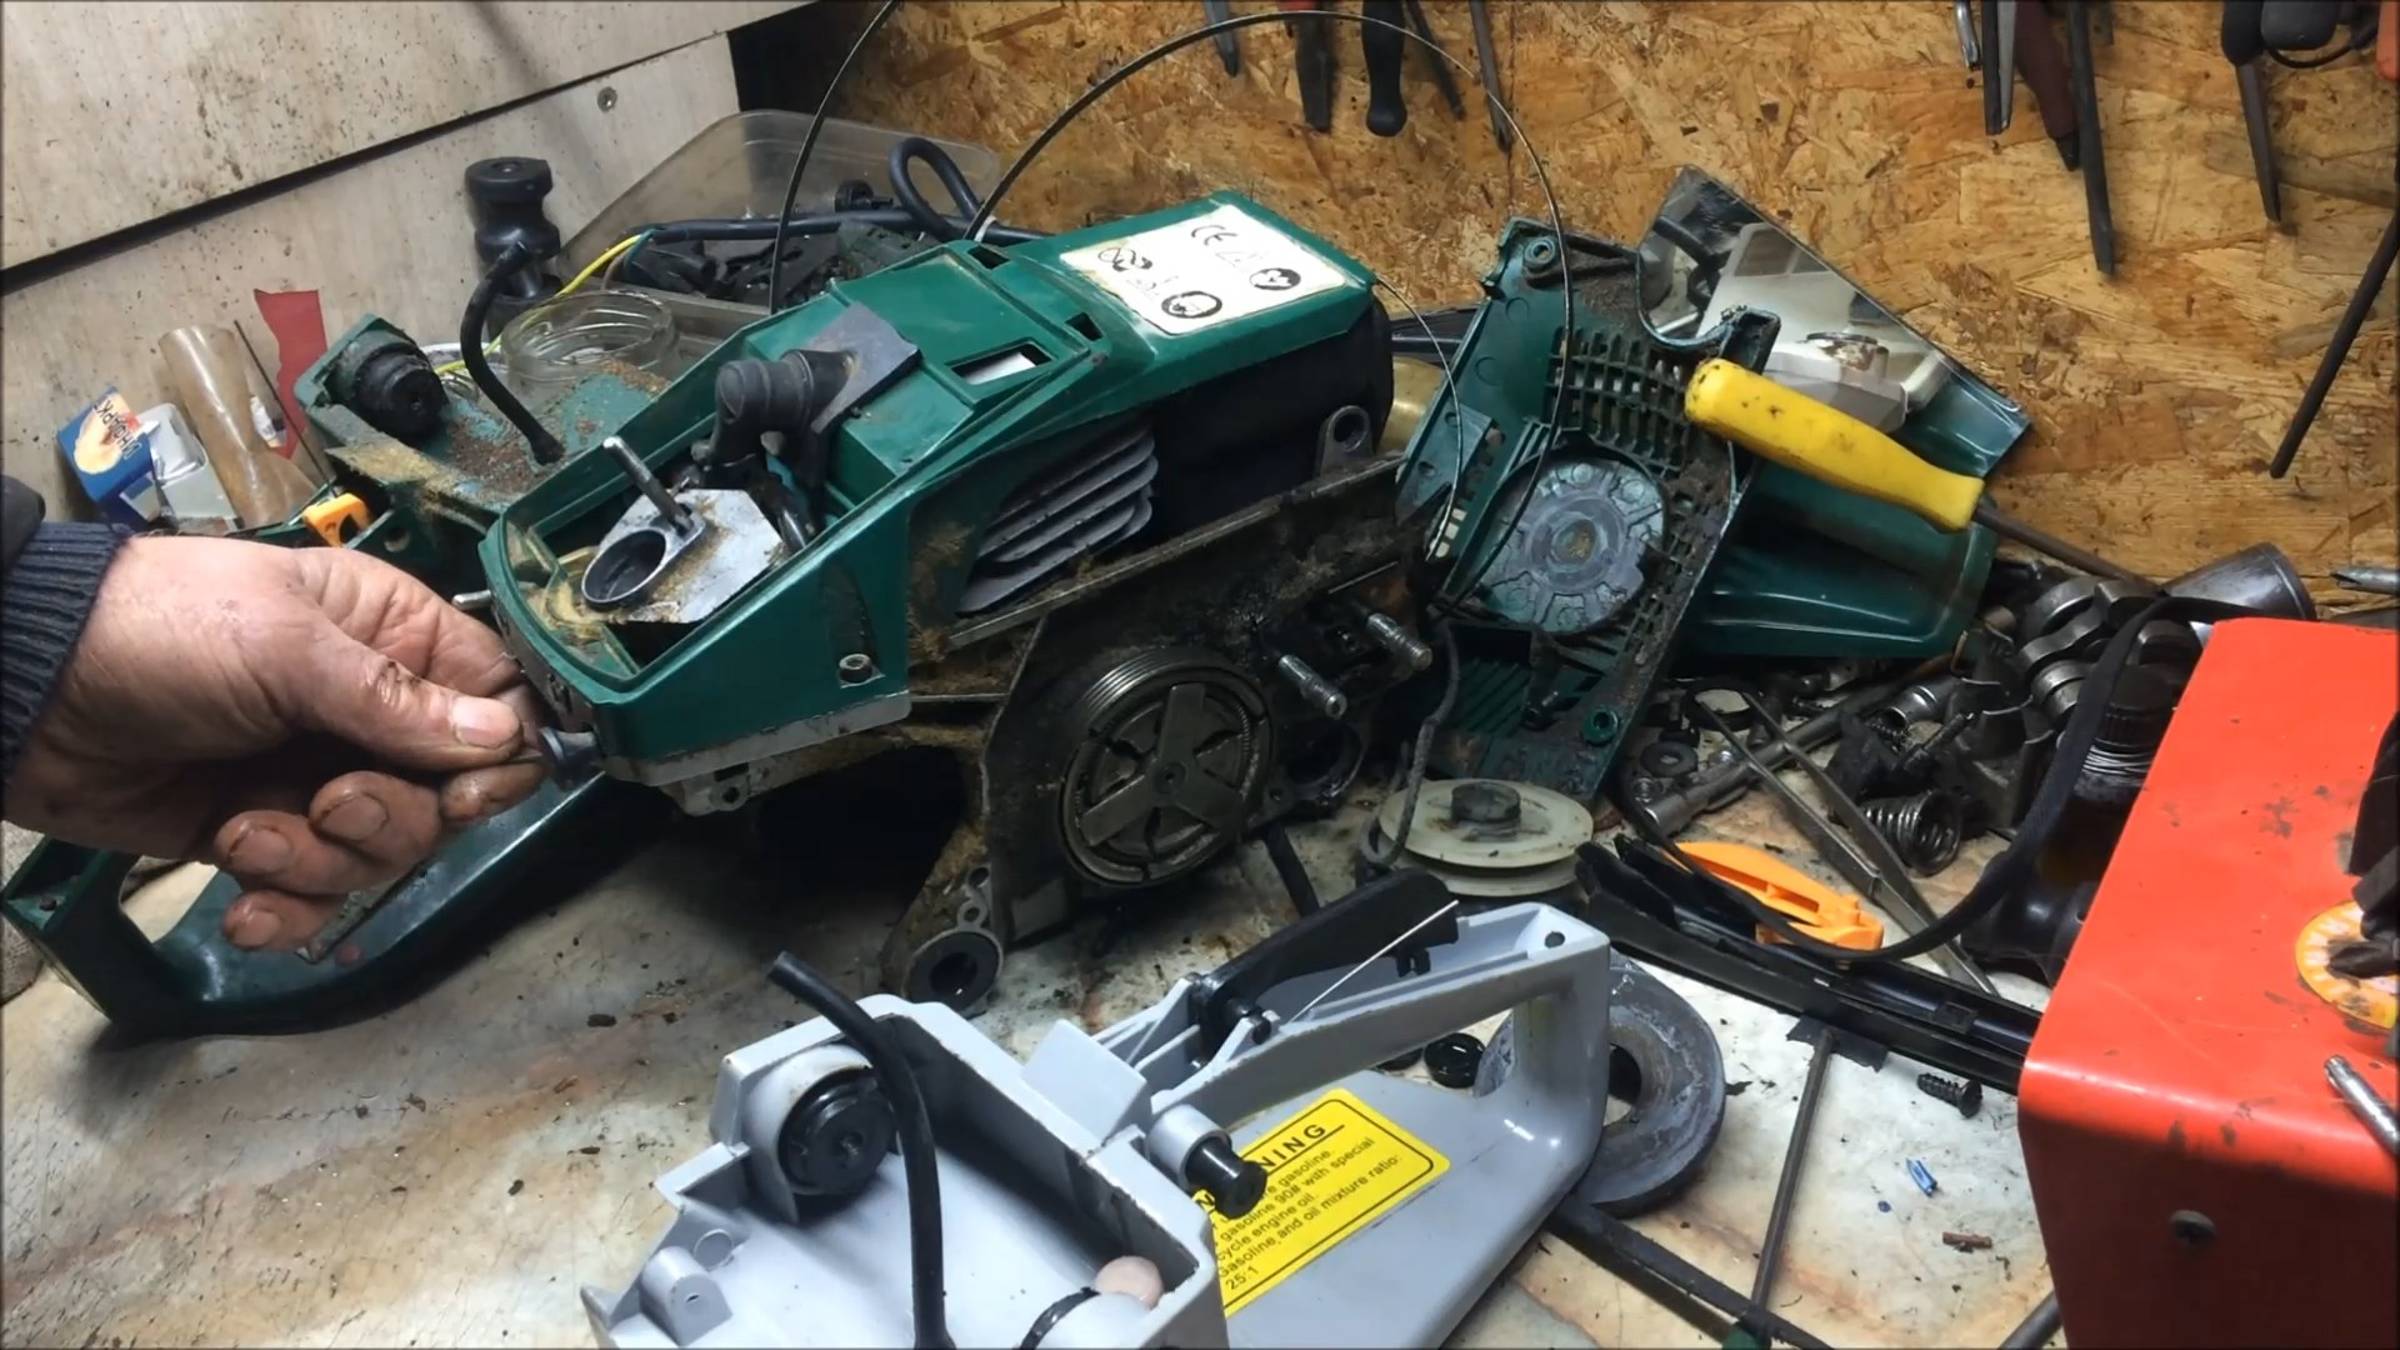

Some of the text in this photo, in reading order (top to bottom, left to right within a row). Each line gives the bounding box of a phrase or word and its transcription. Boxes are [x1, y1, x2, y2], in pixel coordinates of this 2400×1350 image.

[1220, 1204, 1275, 1242] gasoline
[1301, 1168, 1330, 1187] with
[1330, 1137, 1376, 1168] special
[1277, 1217, 1304, 1239] and
[1303, 1206, 1321, 1221] oil
[1321, 1177, 1369, 1209] mixture
[1252, 1206, 1297, 1238] engine
